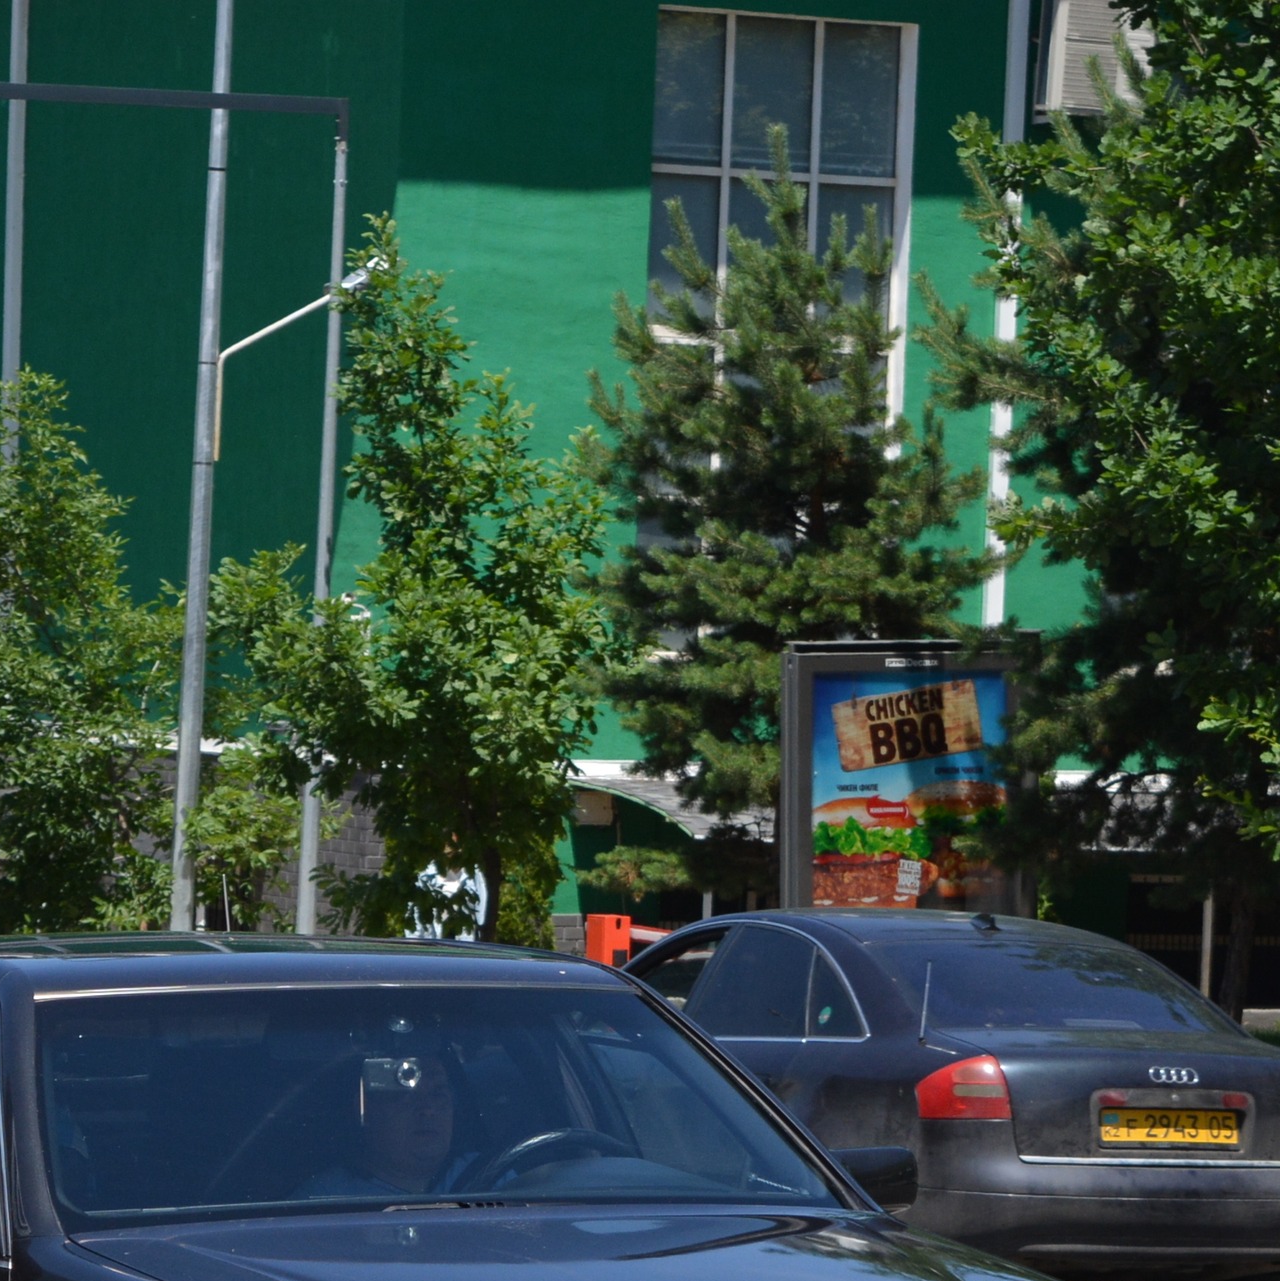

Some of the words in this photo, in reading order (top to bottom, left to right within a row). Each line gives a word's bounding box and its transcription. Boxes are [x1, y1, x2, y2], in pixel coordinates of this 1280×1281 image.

[865, 688, 944, 722] CHICKEN
[870, 713, 948, 764] BBQ
[1126, 1118, 1138, 1138] F
[1144, 1113, 1199, 1139] 2943
[1209, 1116, 1234, 1139] 05
